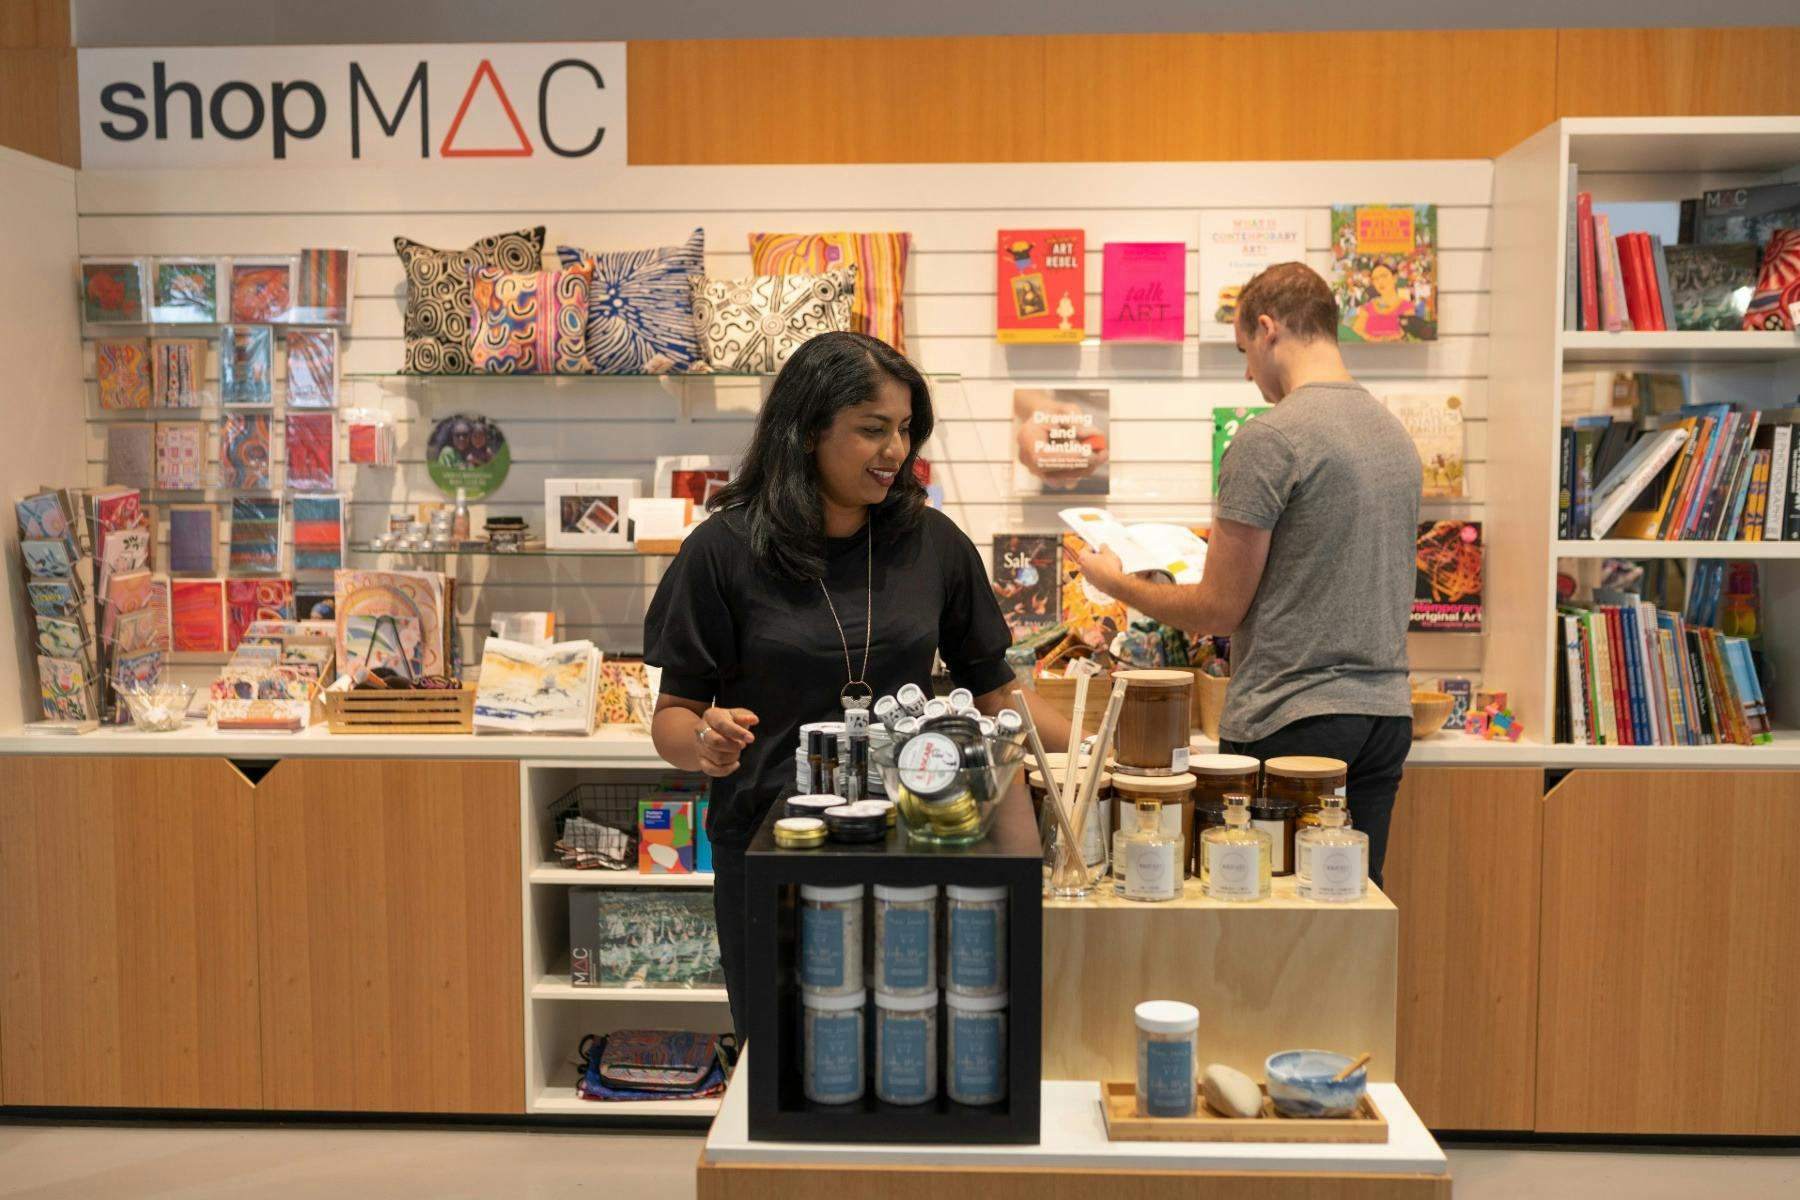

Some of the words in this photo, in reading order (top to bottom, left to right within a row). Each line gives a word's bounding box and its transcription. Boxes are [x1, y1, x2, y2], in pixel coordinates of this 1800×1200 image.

[100, 61, 327, 160] shop
[349, 58, 606, 160] MAC
[1212, 231, 1297, 241] CONTEMPORARY
[1053, 243, 1074, 255] ART
[1046, 256, 1079, 268] REBEL
[1126, 281, 1164, 302] talk
[1119, 303, 1172, 322] ART
[1033, 411, 1093, 427] Drawing
[1049, 426, 1077, 439] and
[1034, 440, 1092, 457] Painting
[1003, 551, 1032, 569] Salt
[572, 947, 589, 985] MAC
